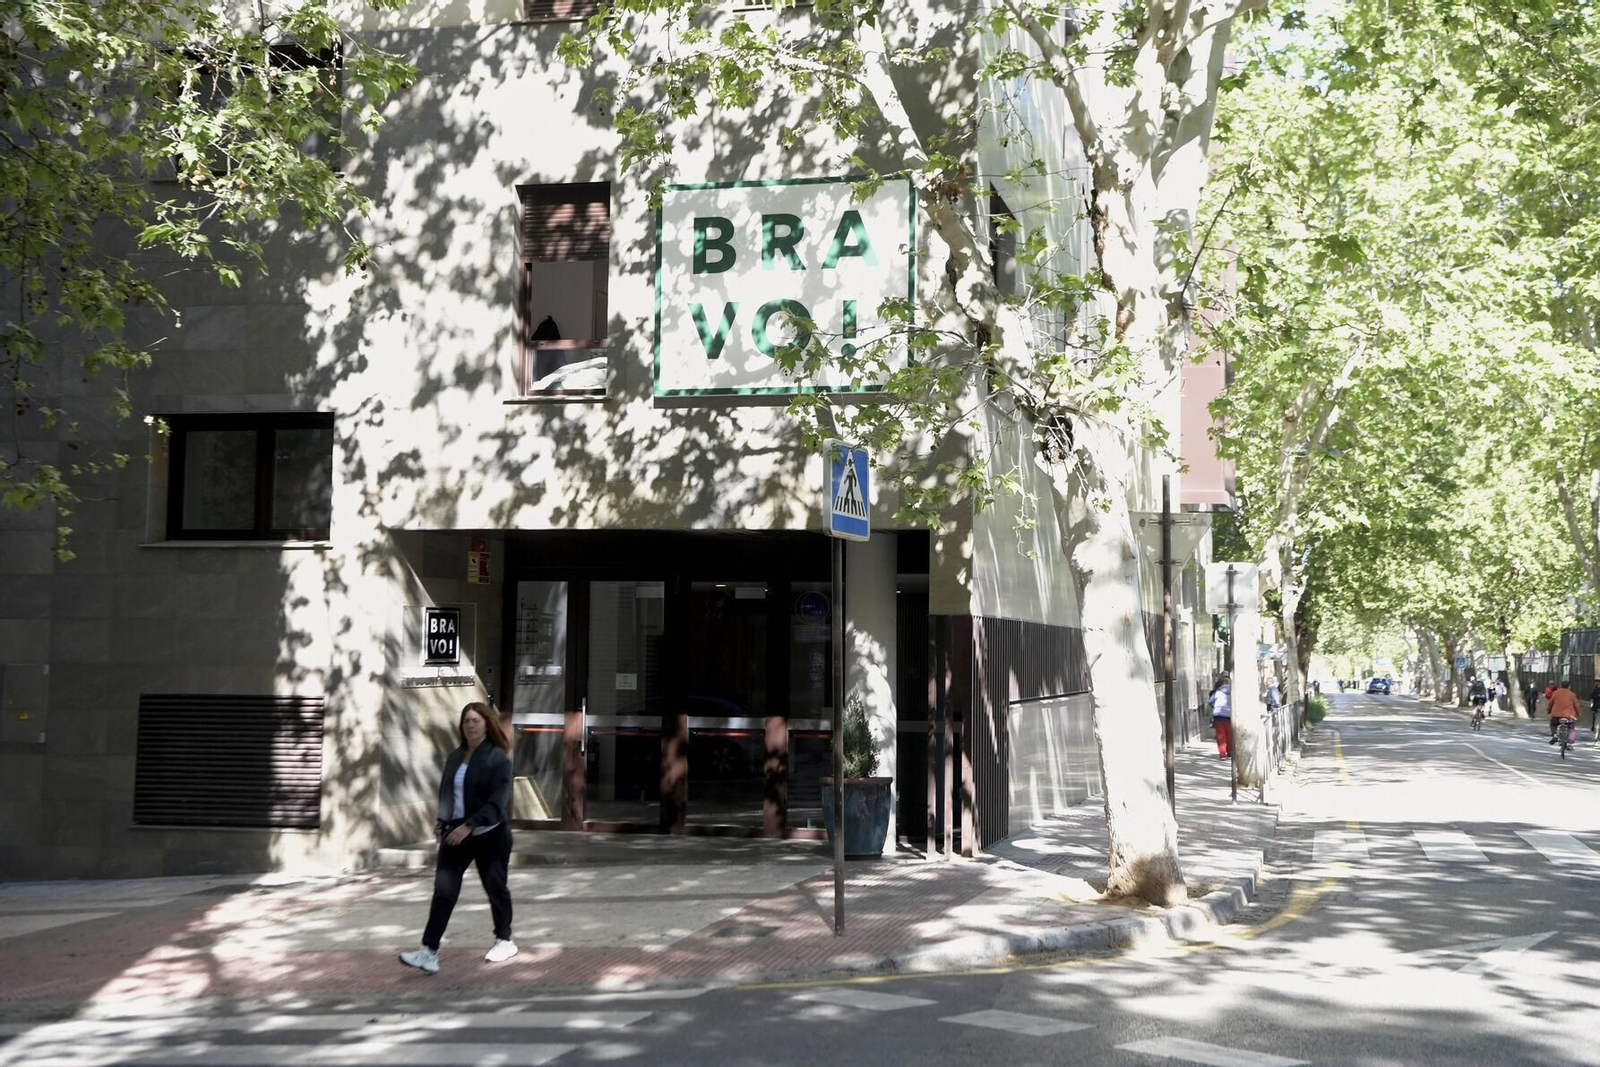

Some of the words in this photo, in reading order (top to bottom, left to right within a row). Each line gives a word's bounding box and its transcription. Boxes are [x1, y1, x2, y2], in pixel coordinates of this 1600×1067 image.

[692, 209, 879, 275] BRA
[687, 298, 857, 360] VO!
[430, 618, 455, 633] BRA
[429, 639, 453, 654] VO!
